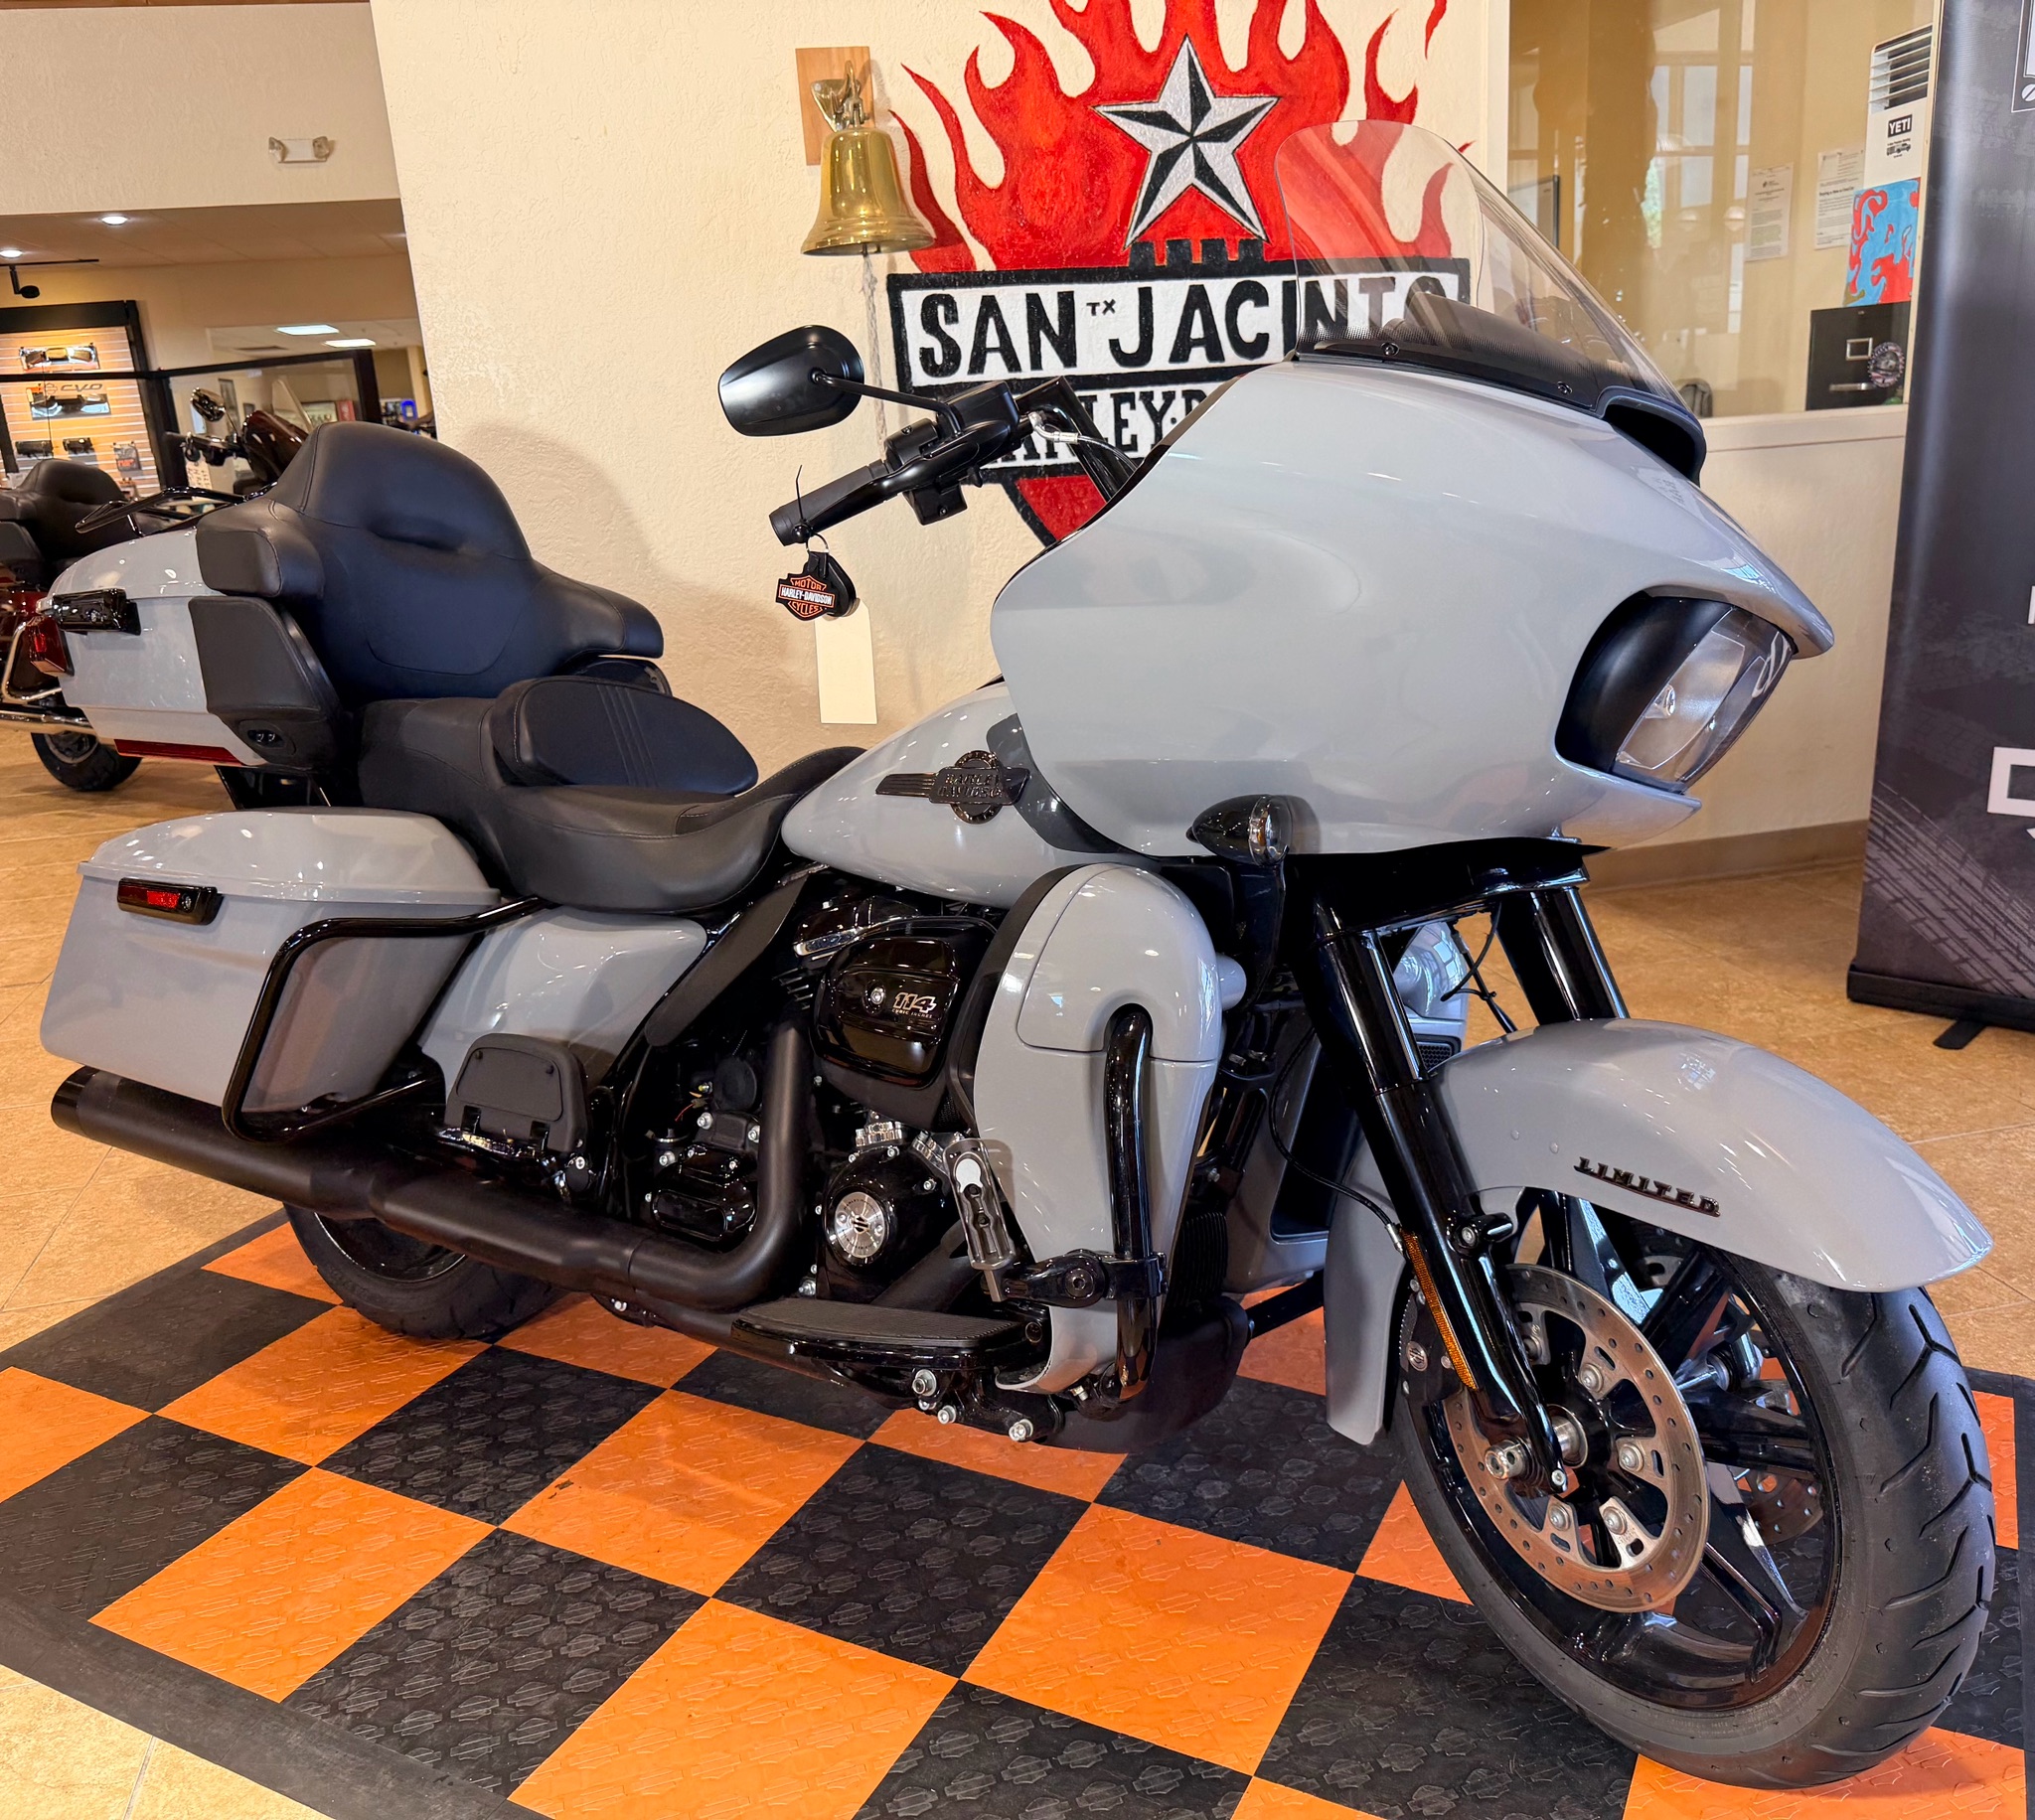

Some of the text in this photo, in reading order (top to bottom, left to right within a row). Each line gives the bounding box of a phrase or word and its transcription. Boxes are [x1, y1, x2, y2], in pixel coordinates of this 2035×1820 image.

[1889, 117, 1911, 135] YETI
[919, 291, 1078, 378] SAN
[1086, 299, 1116, 316] TX
[61, 383, 102, 392] CVO
[794, 578, 823, 591] MOTOR
[781, 586, 833, 605] HARLEY-DAVIDSON
[792, 601, 820, 615] CYCLES
[893, 992, 937, 1013] 114
[1575, 1155, 1721, 1216] LIMITED
